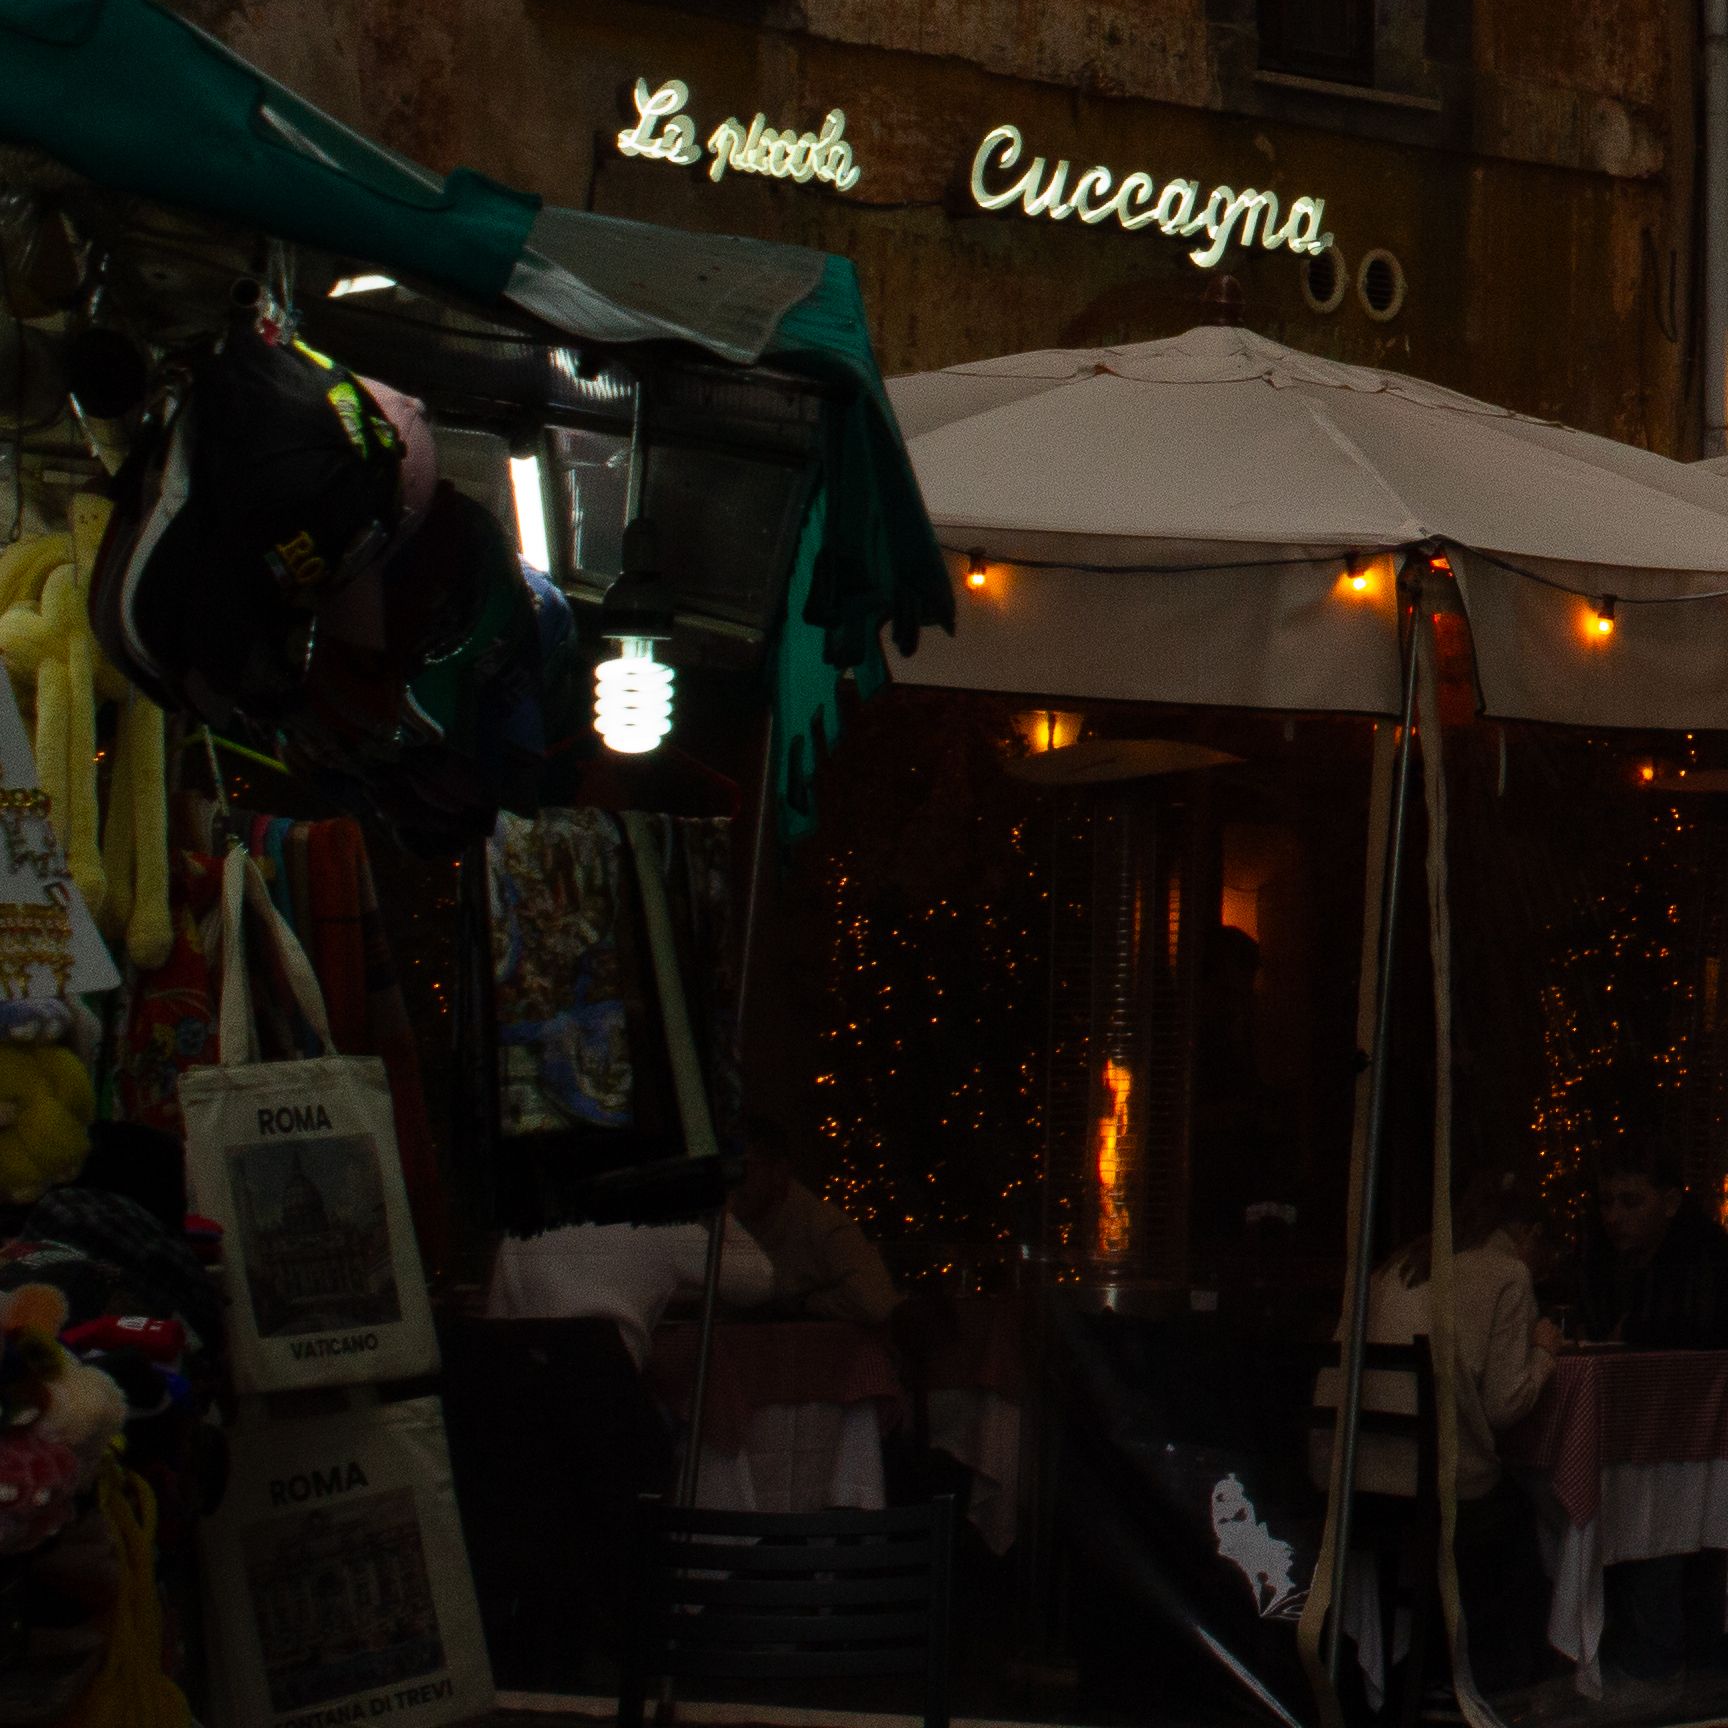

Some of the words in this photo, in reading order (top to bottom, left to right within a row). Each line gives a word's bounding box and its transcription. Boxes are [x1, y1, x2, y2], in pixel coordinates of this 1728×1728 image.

[616, 76, 703, 166] La
[969, 123, 1336, 269] Cuccagna
[257, 1103, 333, 1136] ROMA
[289, 1332, 381, 1363] VATICANO
[269, 1459, 371, 1508] ROMA
[369, 1694, 392, 1717] DI
[394, 1677, 455, 1709] TREVI
